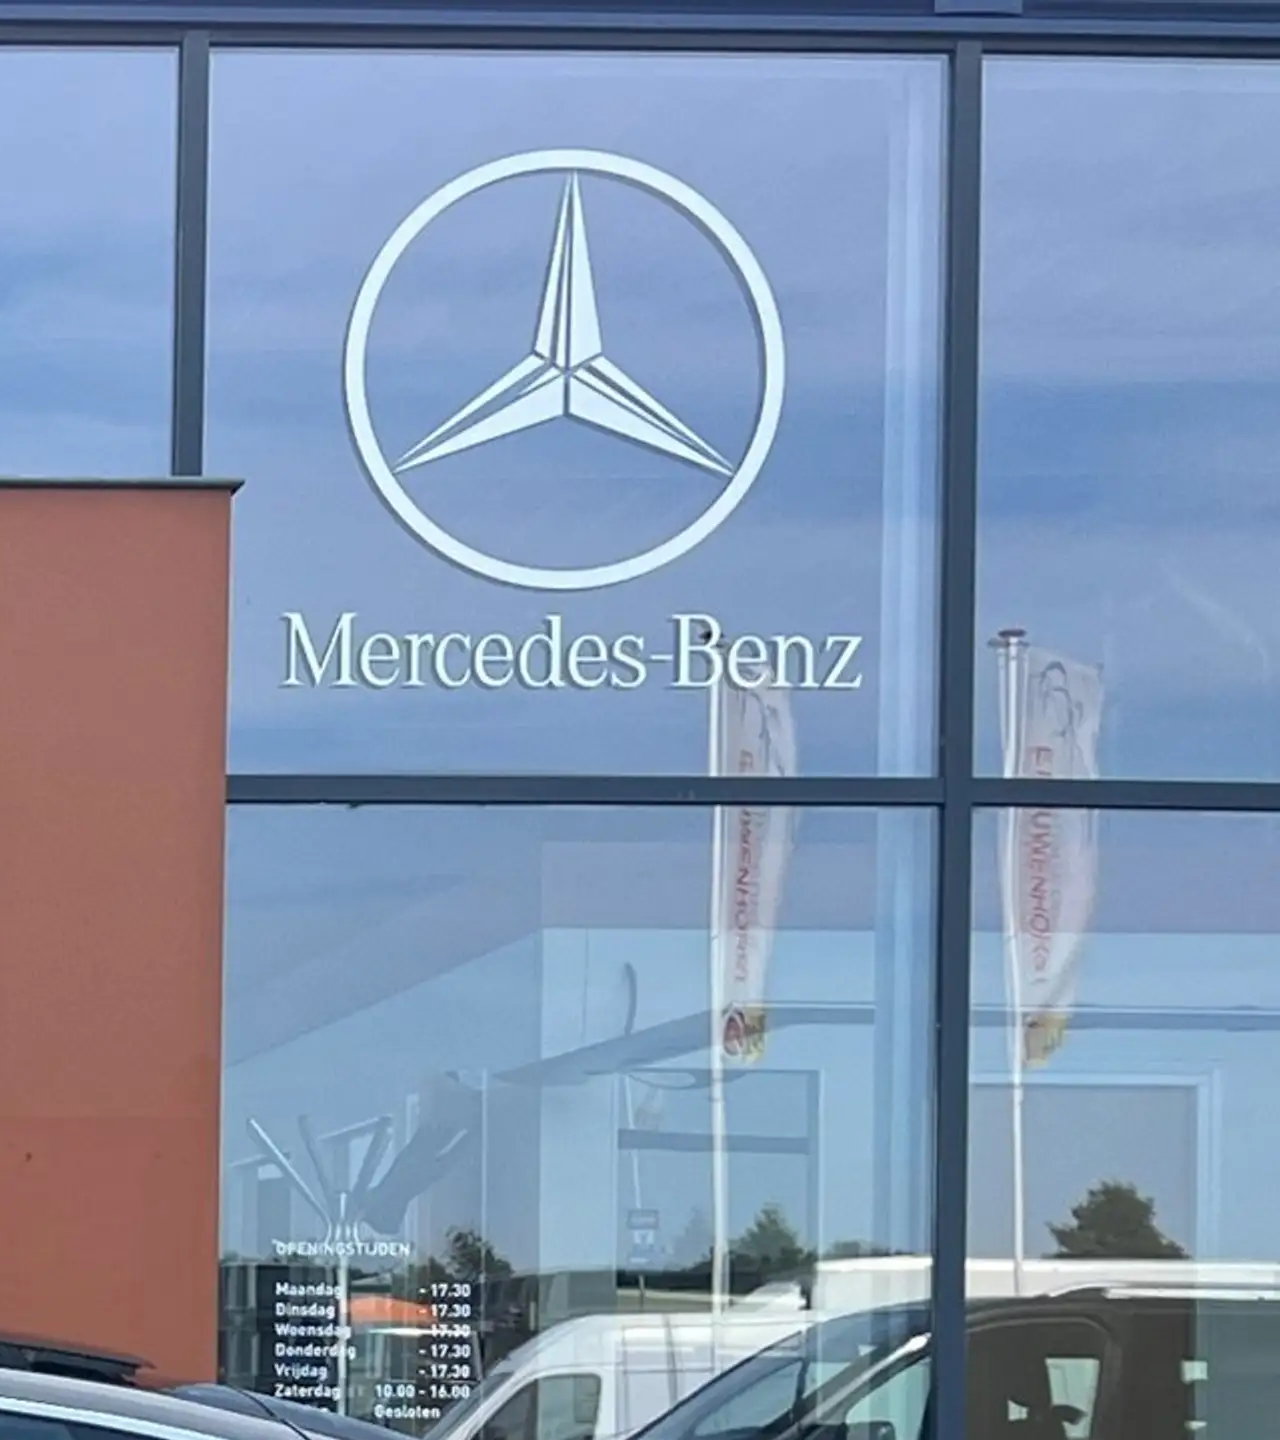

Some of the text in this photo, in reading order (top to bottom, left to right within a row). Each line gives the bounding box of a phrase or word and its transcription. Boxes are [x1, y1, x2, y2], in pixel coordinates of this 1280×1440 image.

[282, 611, 863, 689] Mercedes-Benz
[275, 1241, 411, 1256] OPENINGSTIJDEN
[275, 1282, 342, 1299] Maandag
[430, 1283, 471, 1298] 17.30
[275, 1303, 336, 1319] Dinsdag
[430, 1303, 471, 1318] 17.30
[274, 1323, 351, 1340] Woensdag
[274, 1343, 357, 1360] Donderdag
[430, 1344, 471, 1359] 17.30
[274, 1363, 329, 1380] Vrijdag
[430, 1364, 471, 1379] 17.30
[274, 1383, 341, 1400] Zaterdag
[374, 1404, 441, 1419] Gesloten
